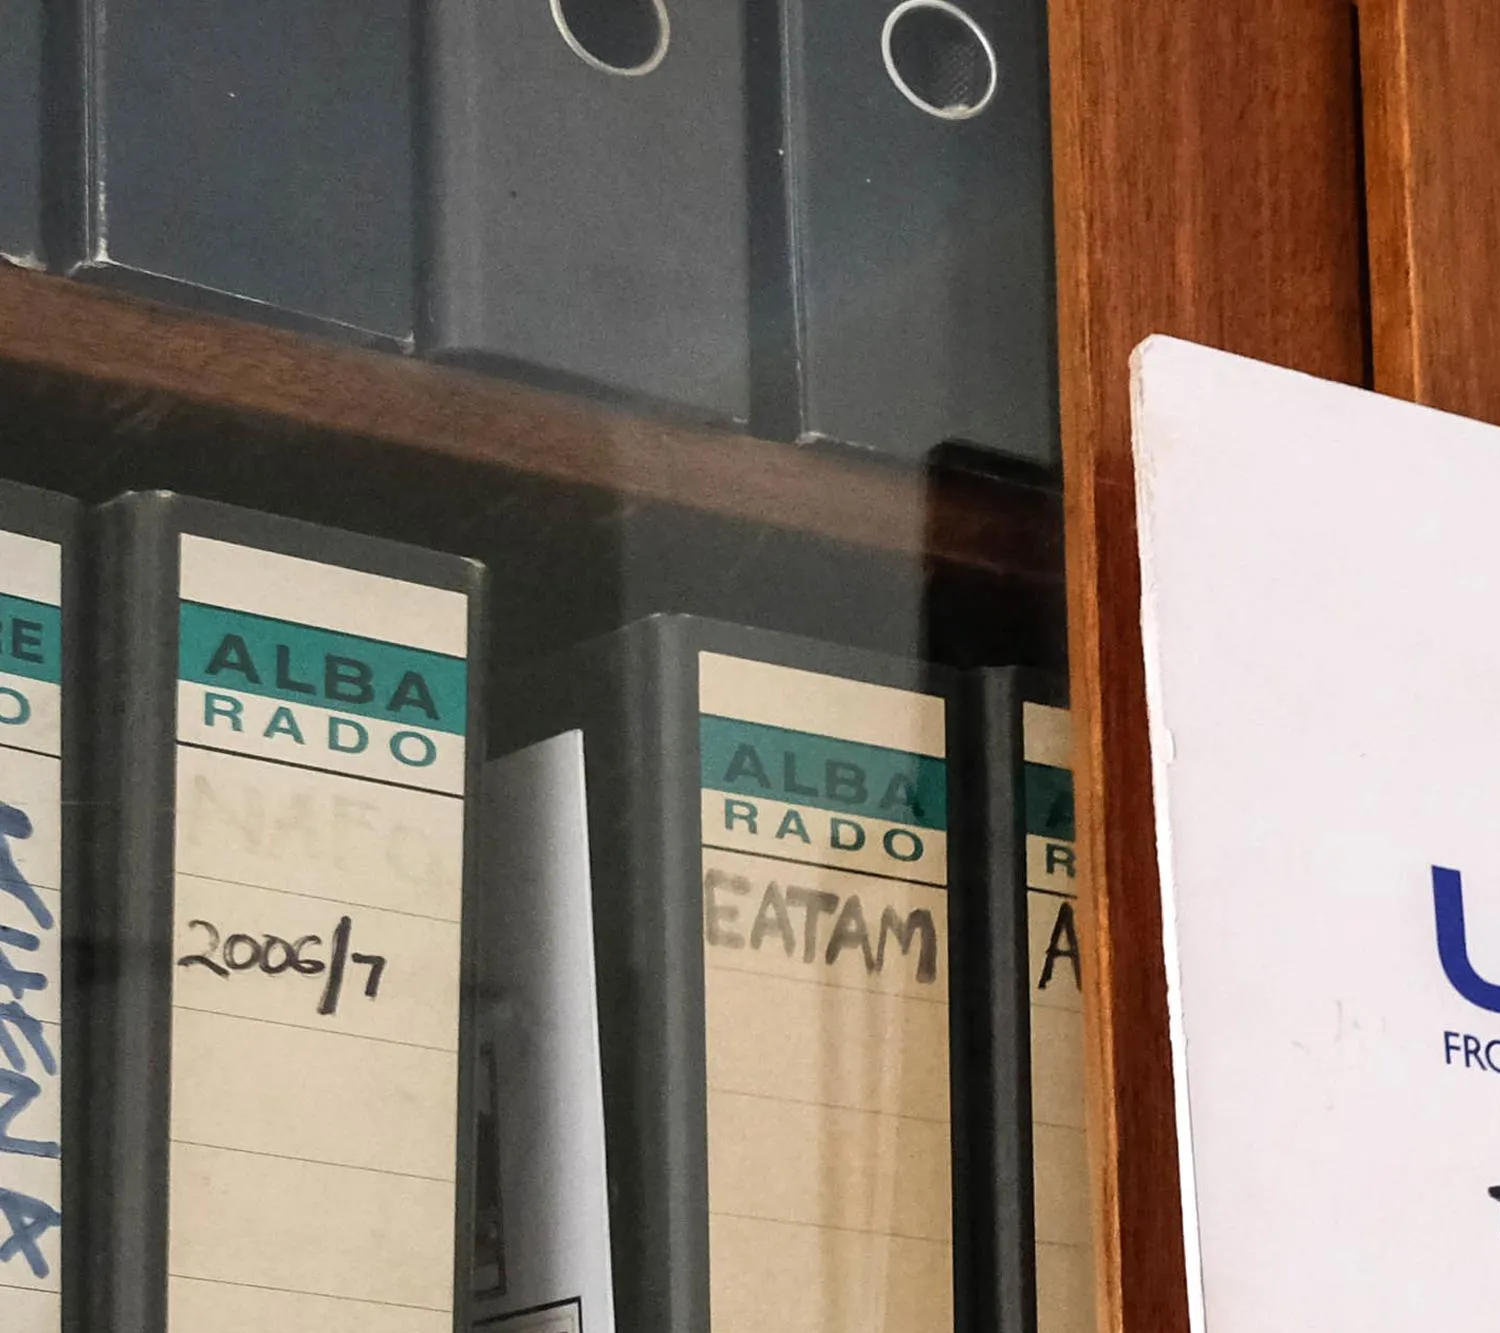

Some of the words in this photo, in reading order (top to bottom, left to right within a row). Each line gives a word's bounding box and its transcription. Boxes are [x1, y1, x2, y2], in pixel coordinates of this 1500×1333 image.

[0, 618, 44, 664] E
[205, 633, 440, 721] ALBA
[203, 692, 437, 768] RADO
[723, 743, 925, 818] ALBA
[724, 798, 924, 861] RADO
[178, 916, 385, 1016] 2006/7
